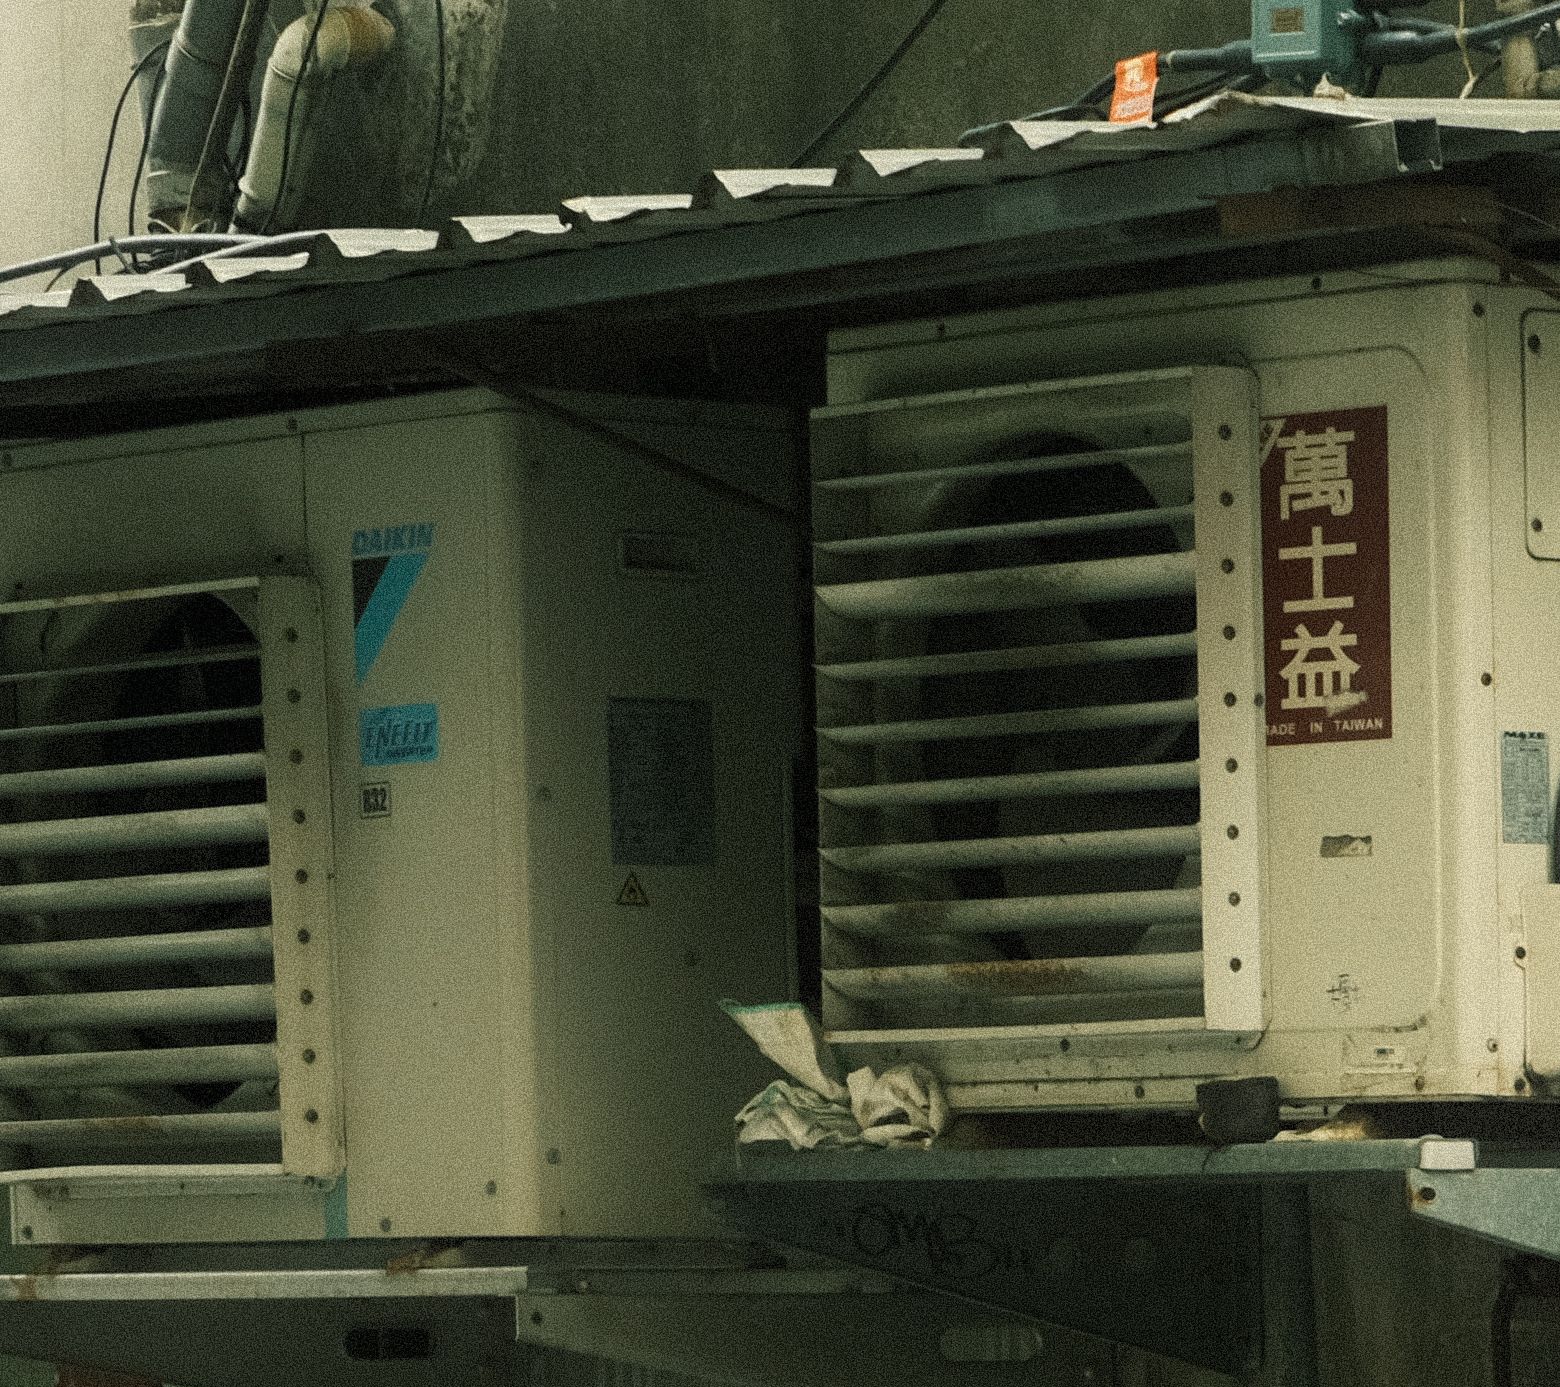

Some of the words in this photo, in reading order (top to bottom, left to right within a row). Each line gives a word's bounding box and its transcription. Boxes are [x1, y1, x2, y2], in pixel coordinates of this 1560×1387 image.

[352, 523, 434, 555] DAIKIN
[1276, 427, 1362, 712] 萬士益
[1309, 720, 1324, 734] IN
[1333, 716, 1385, 732] TAIWAN
